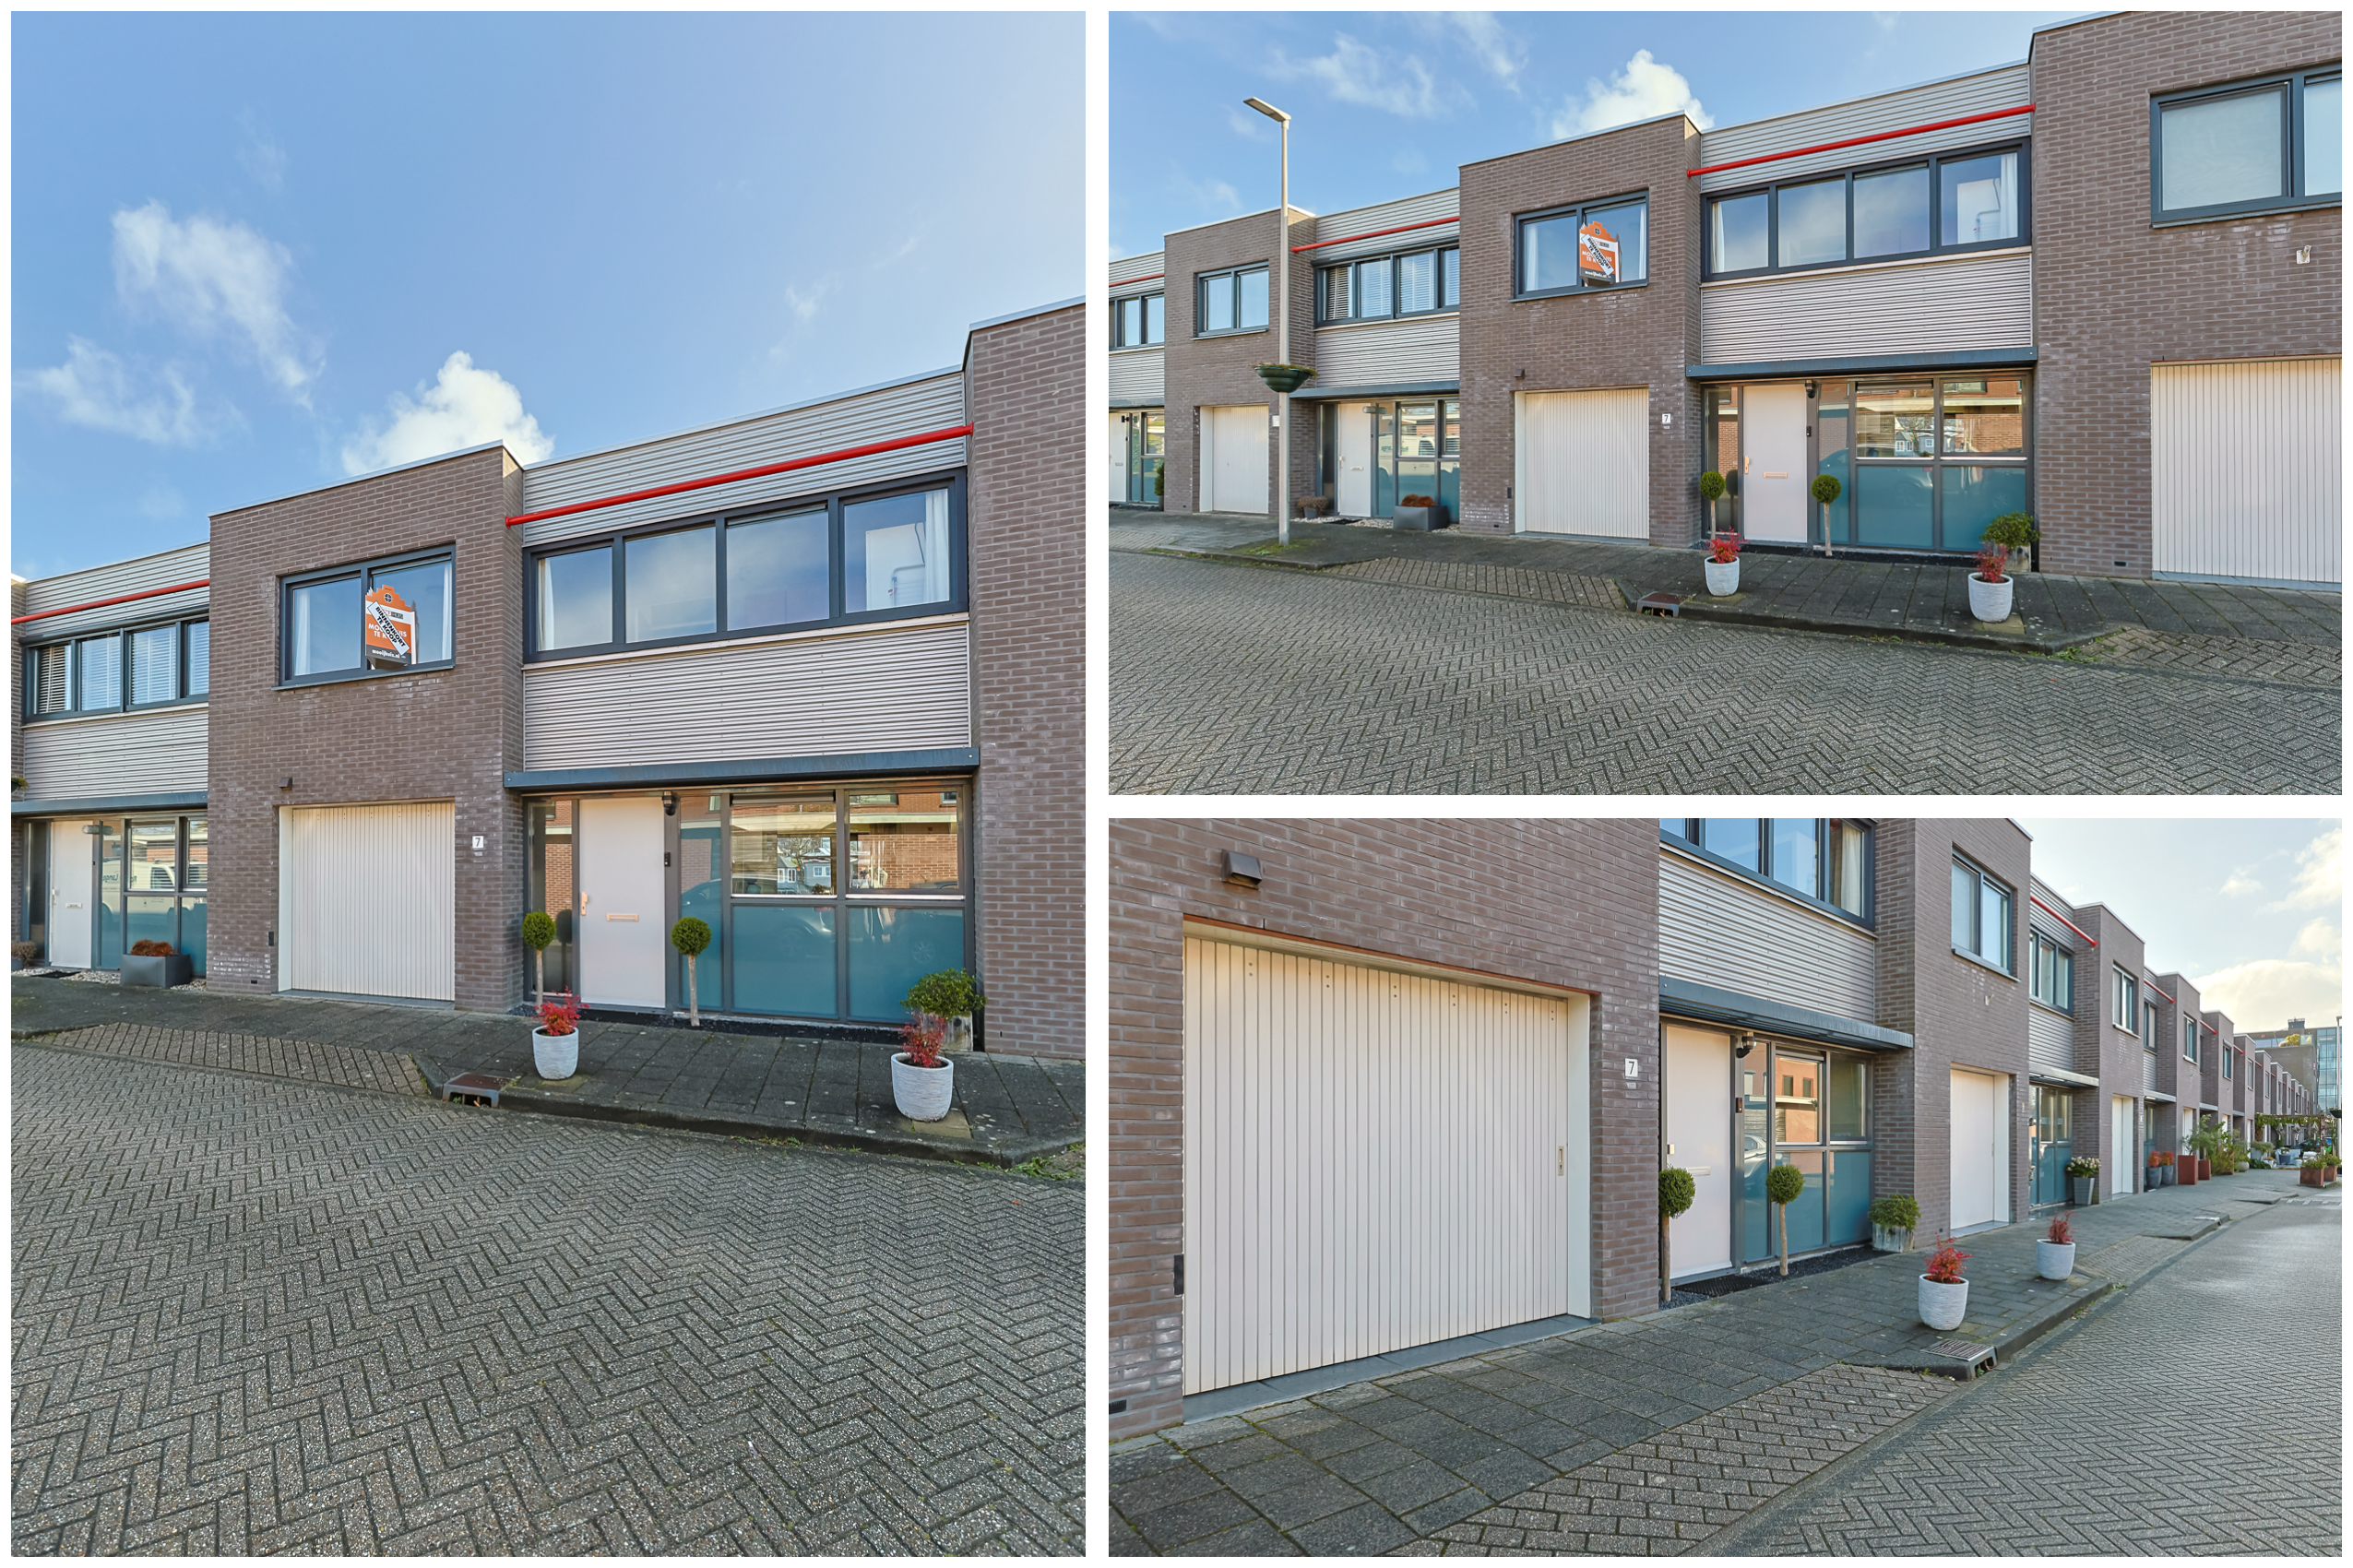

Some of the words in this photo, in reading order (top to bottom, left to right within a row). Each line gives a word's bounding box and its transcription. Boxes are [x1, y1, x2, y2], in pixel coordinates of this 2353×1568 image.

[1593, 251, 1605, 267] KOOP
[375, 606, 406, 647] BINNENKORT
[376, 615, 384, 624] TE
[383, 624, 397, 644] KOOP
[475, 837, 481, 848] 7
[1628, 1061, 1634, 1075] 7
